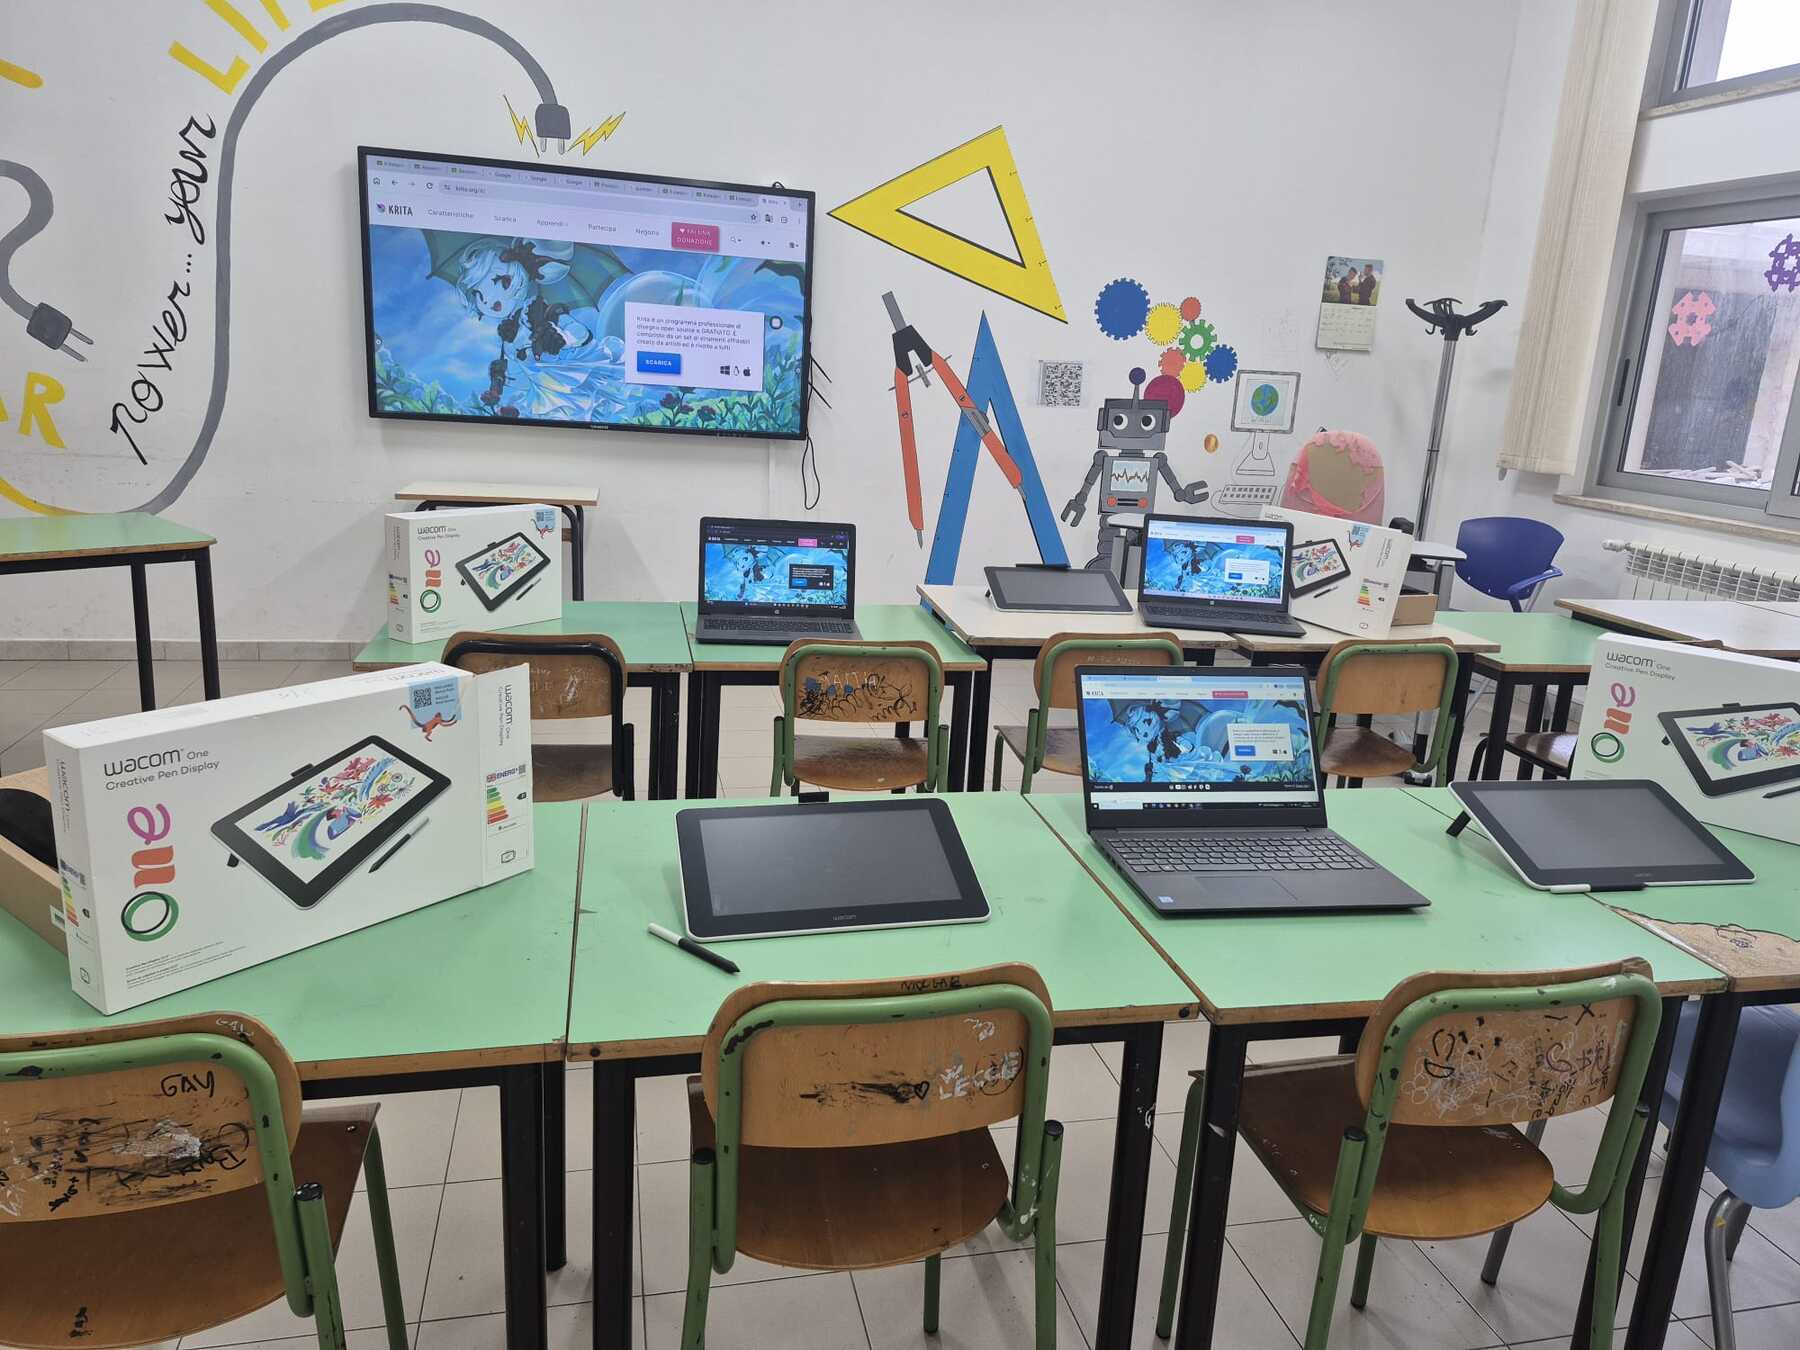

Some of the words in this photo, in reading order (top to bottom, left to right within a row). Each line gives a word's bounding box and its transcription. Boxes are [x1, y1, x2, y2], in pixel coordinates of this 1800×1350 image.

[164, 113, 216, 245] your
[388, 205, 413, 216] KRITA
[645, 359, 672, 368] SCARICA
[186, 749, 210, 761] One
[105, 772, 155, 792] Creative
[157, 769, 179, 782] Pen
[180, 759, 220, 776] Display
[160, 1070, 215, 1098] GAY
